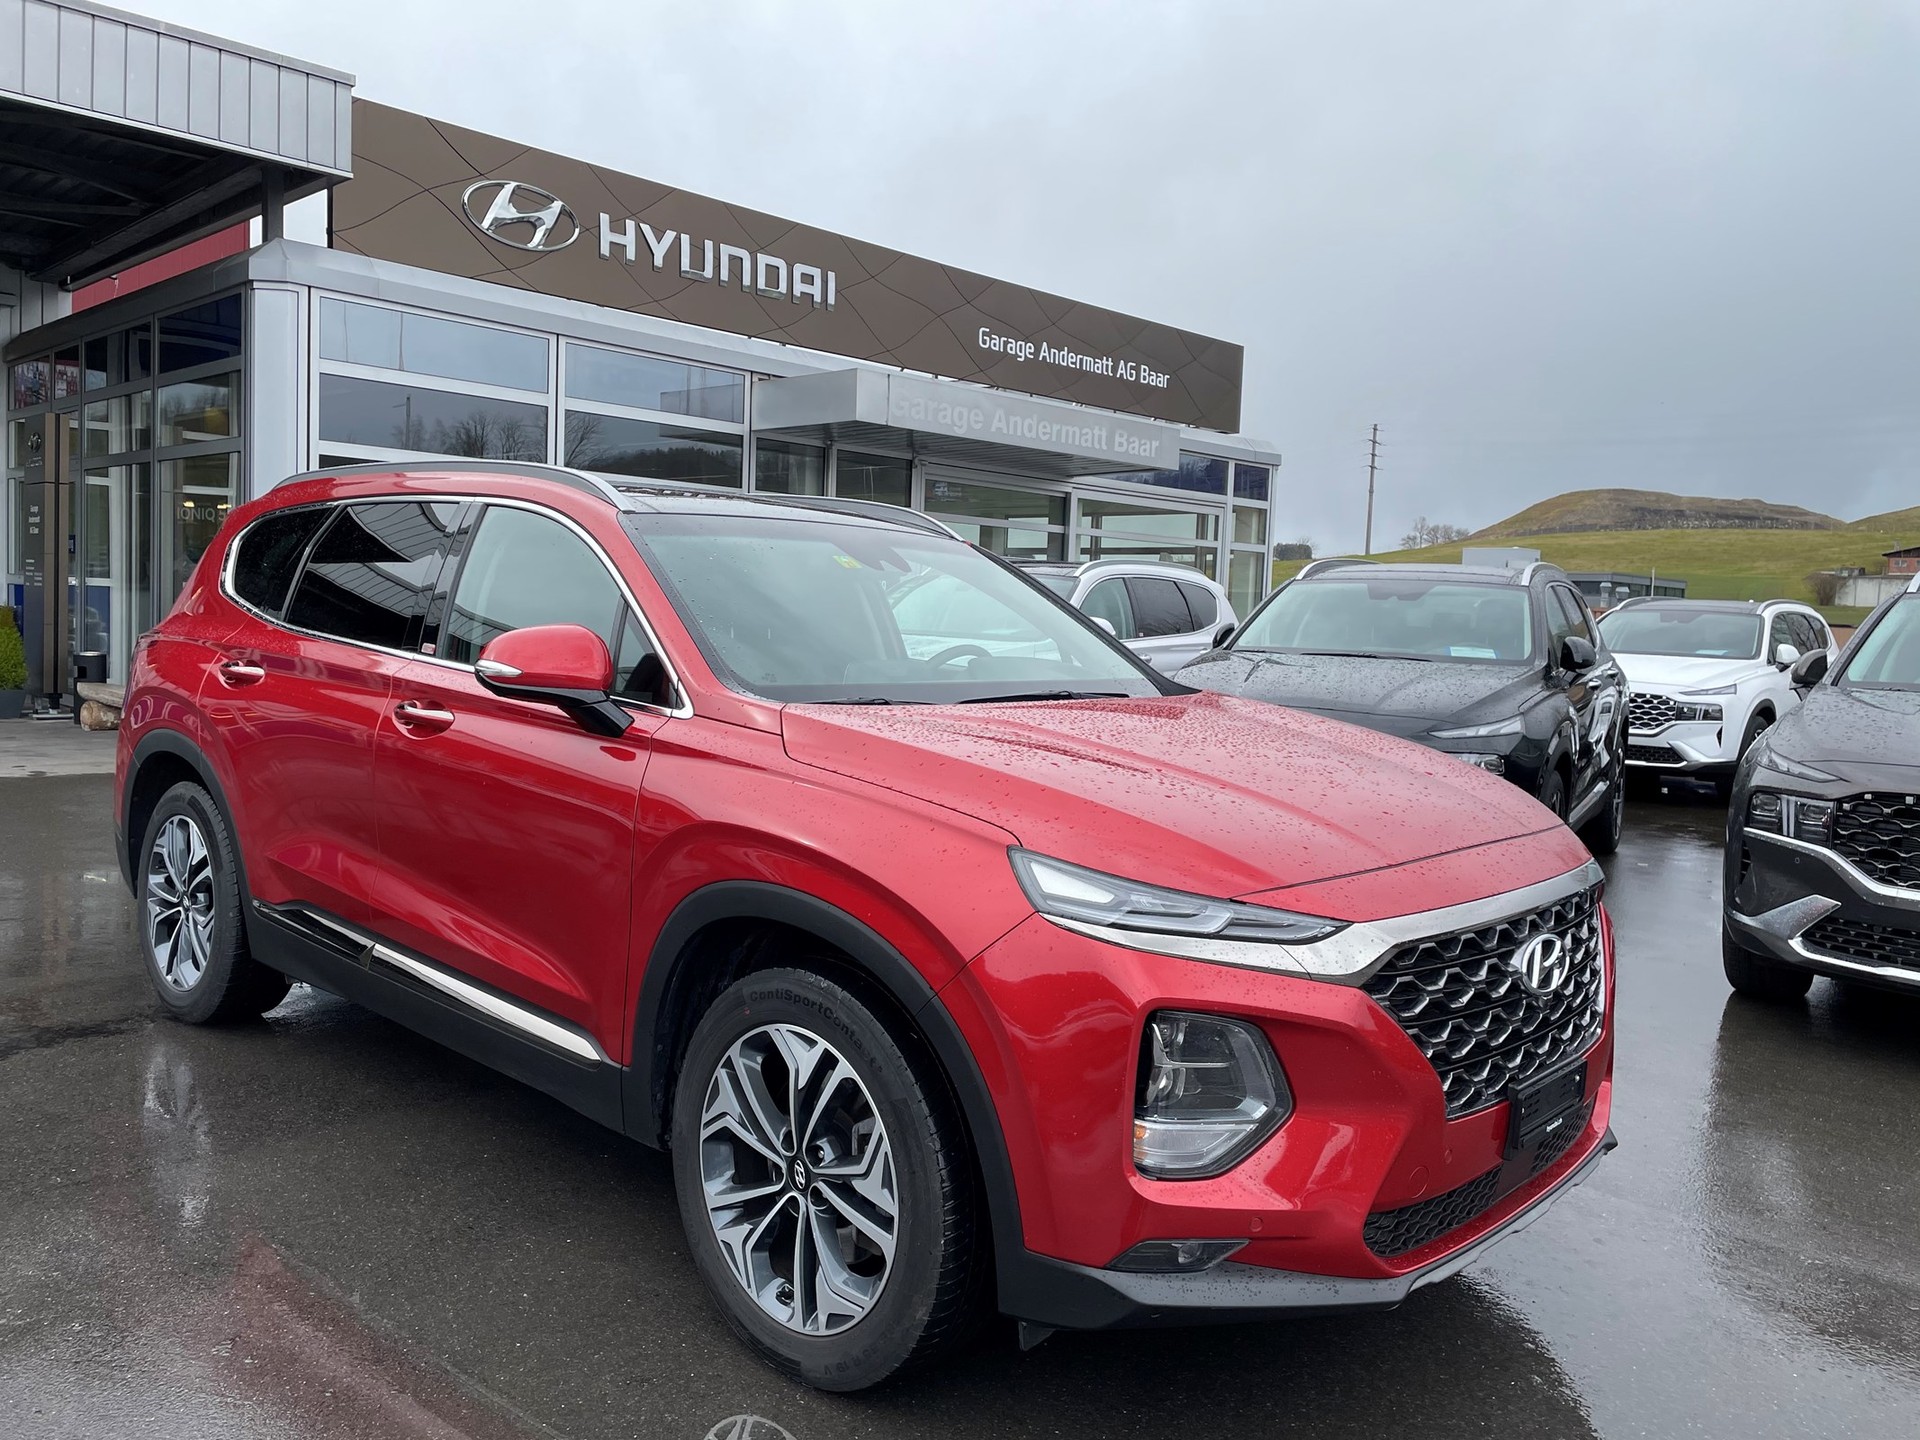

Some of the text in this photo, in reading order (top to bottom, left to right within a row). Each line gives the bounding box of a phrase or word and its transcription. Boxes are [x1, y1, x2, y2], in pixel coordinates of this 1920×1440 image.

[599, 212, 837, 311] HYUNDAI
[978, 327, 1171, 388] Garage Andermatt AG Baar
[889, 396, 1160, 459] Garage Andermatt Baar
[177, 506, 216, 523] IONIQ
